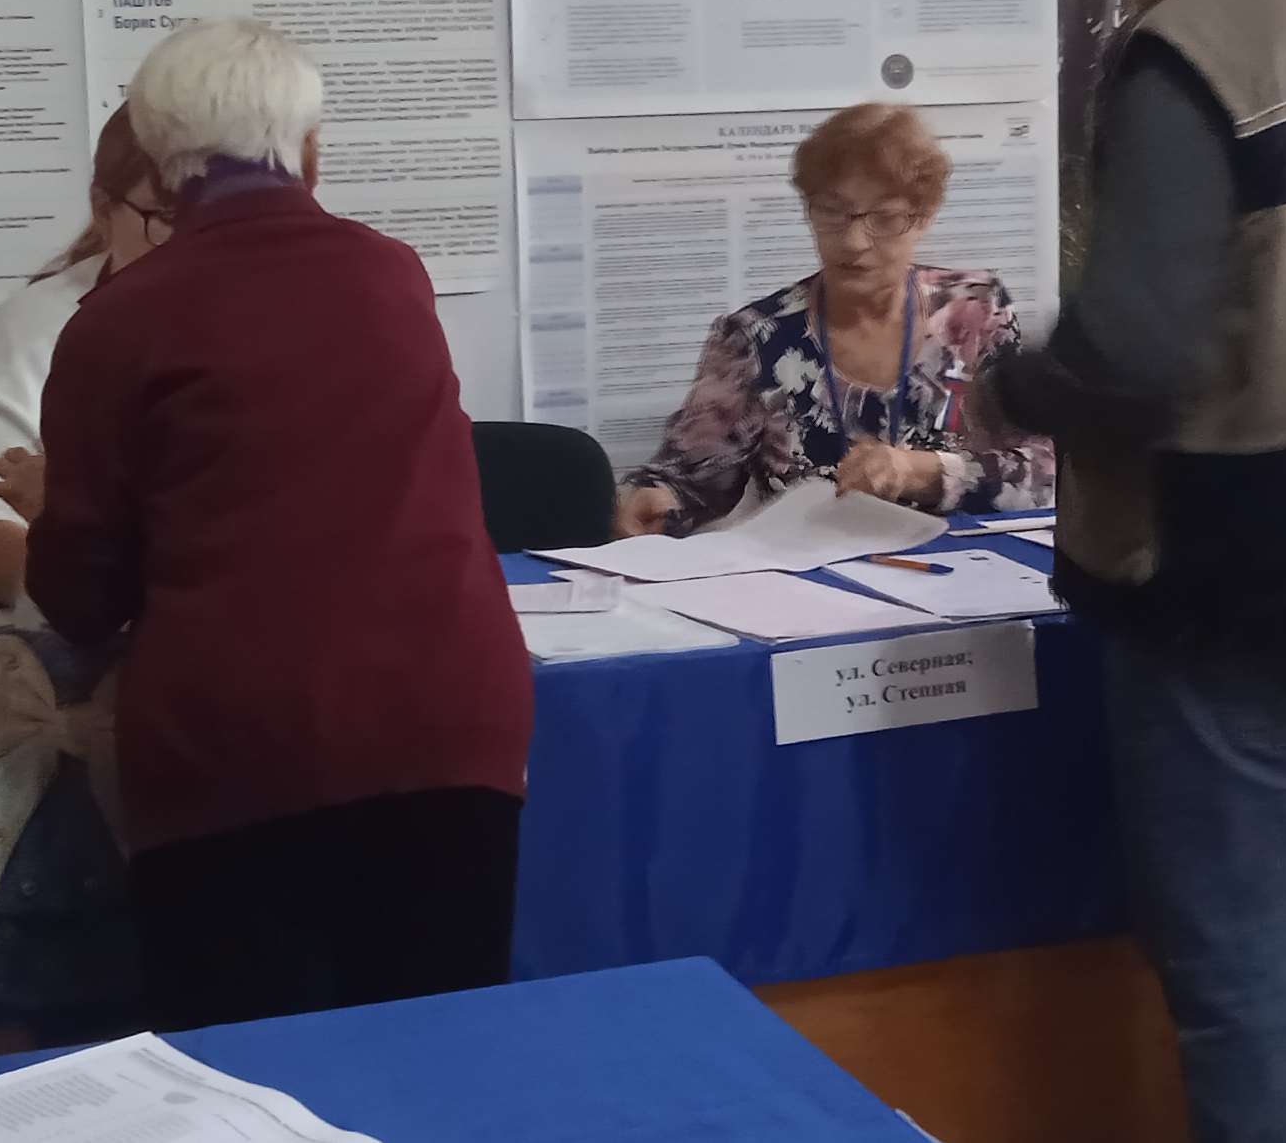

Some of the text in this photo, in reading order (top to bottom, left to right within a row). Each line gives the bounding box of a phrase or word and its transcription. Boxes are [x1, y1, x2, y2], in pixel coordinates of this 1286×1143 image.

[113, 15, 157, 32] Борис
[835, 652, 973, 687] ул. Северная;
[846, 679, 967, 713] ул. Степная
